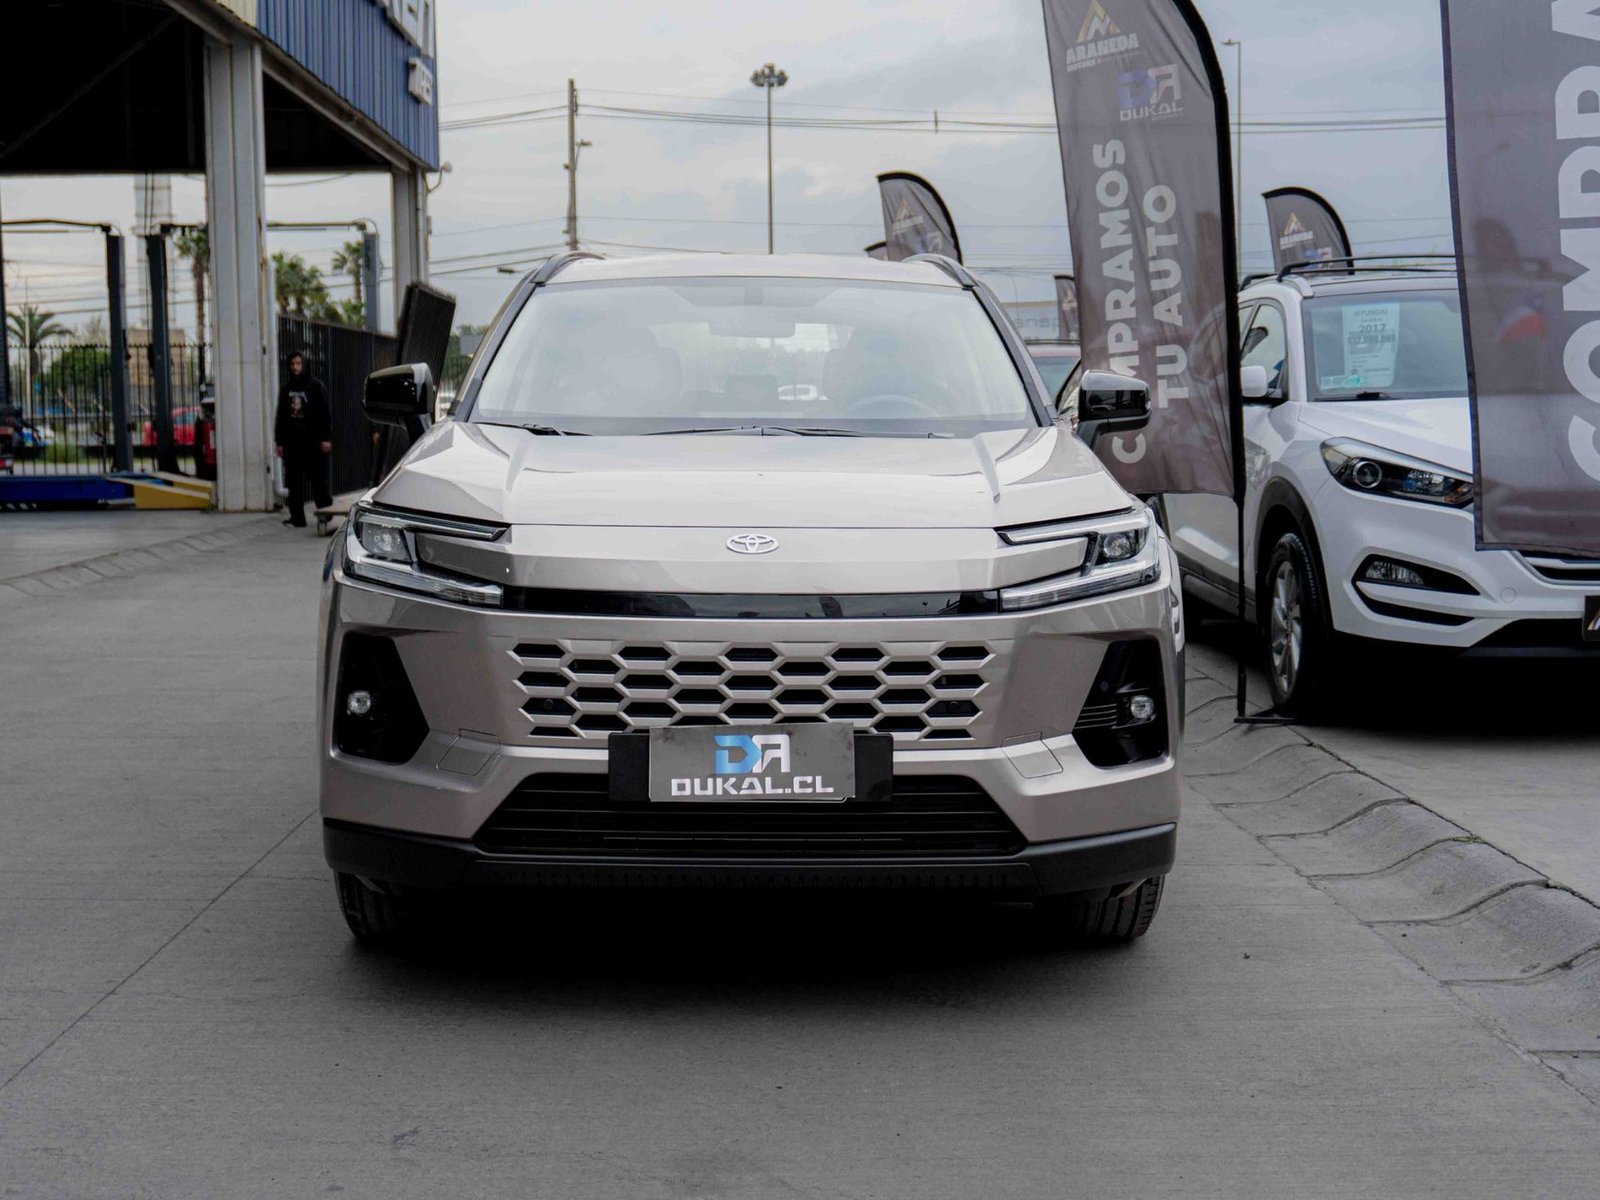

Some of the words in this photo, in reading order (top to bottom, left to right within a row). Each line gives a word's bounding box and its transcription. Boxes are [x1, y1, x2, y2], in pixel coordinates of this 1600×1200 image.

[1066, 33, 1140, 65] ARANEDA
[1120, 102, 1184, 121] DUKAL
[1142, 184, 1184, 327] AUTO
[1092, 139, 1147, 464] CMPRAMOS
[1358, 323, 1387, 334] 2017
[1156, 344, 1189, 409] TU
[671, 775, 834, 796] DUKAL.CL
